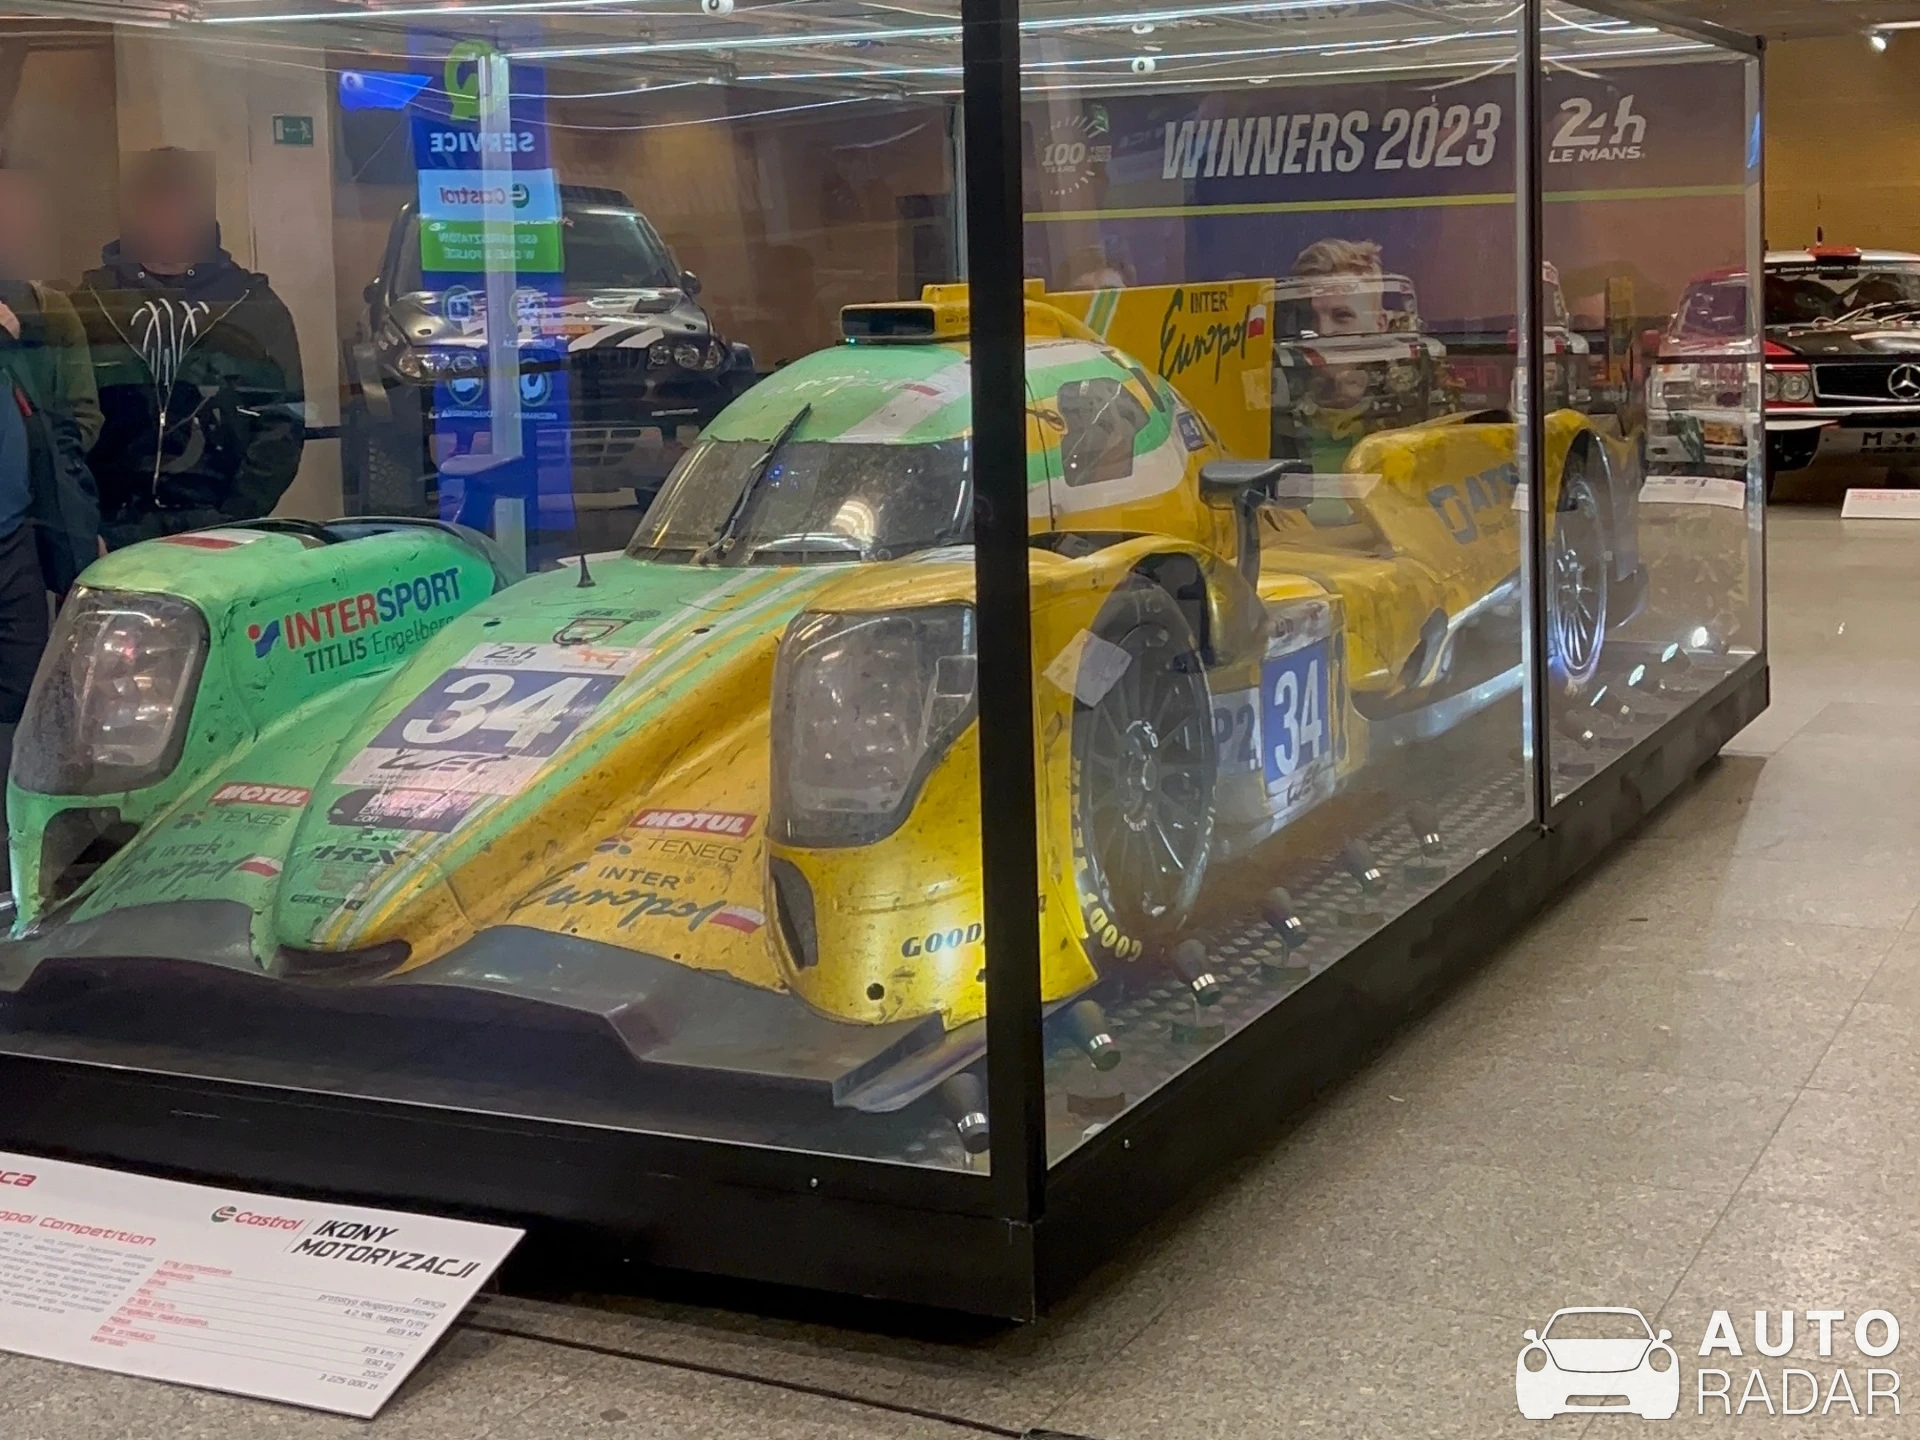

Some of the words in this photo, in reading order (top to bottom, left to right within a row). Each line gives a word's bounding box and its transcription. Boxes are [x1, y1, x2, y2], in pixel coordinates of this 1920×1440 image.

[1162, 107, 1370, 180] WINNERS
[1376, 102, 1502, 170] 2023
[1042, 142, 1086, 166] 100
[1548, 149, 1575, 163] LE
[1578, 146, 1641, 161] MANS
[1190, 291, 1229, 314] INTER
[285, 567, 462, 650] INTERSPORT
[303, 637, 368, 675] TITLIS
[403, 673, 592, 748] 34
[1274, 659, 1322, 775] 34
[215, 785, 309, 805] MOTUL
[636, 811, 747, 834] MOTUL
[647, 838, 742, 864] TENEG
[597, 865, 681, 890] INTER
[0, 1169, 37, 1187] ca
[39, 1217, 157, 1247] Competition
[235, 1211, 304, 1231] Castrol
[313, 1219, 399, 1243] IKONY
[291, 1238, 481, 1279] MOTORYZACJI
